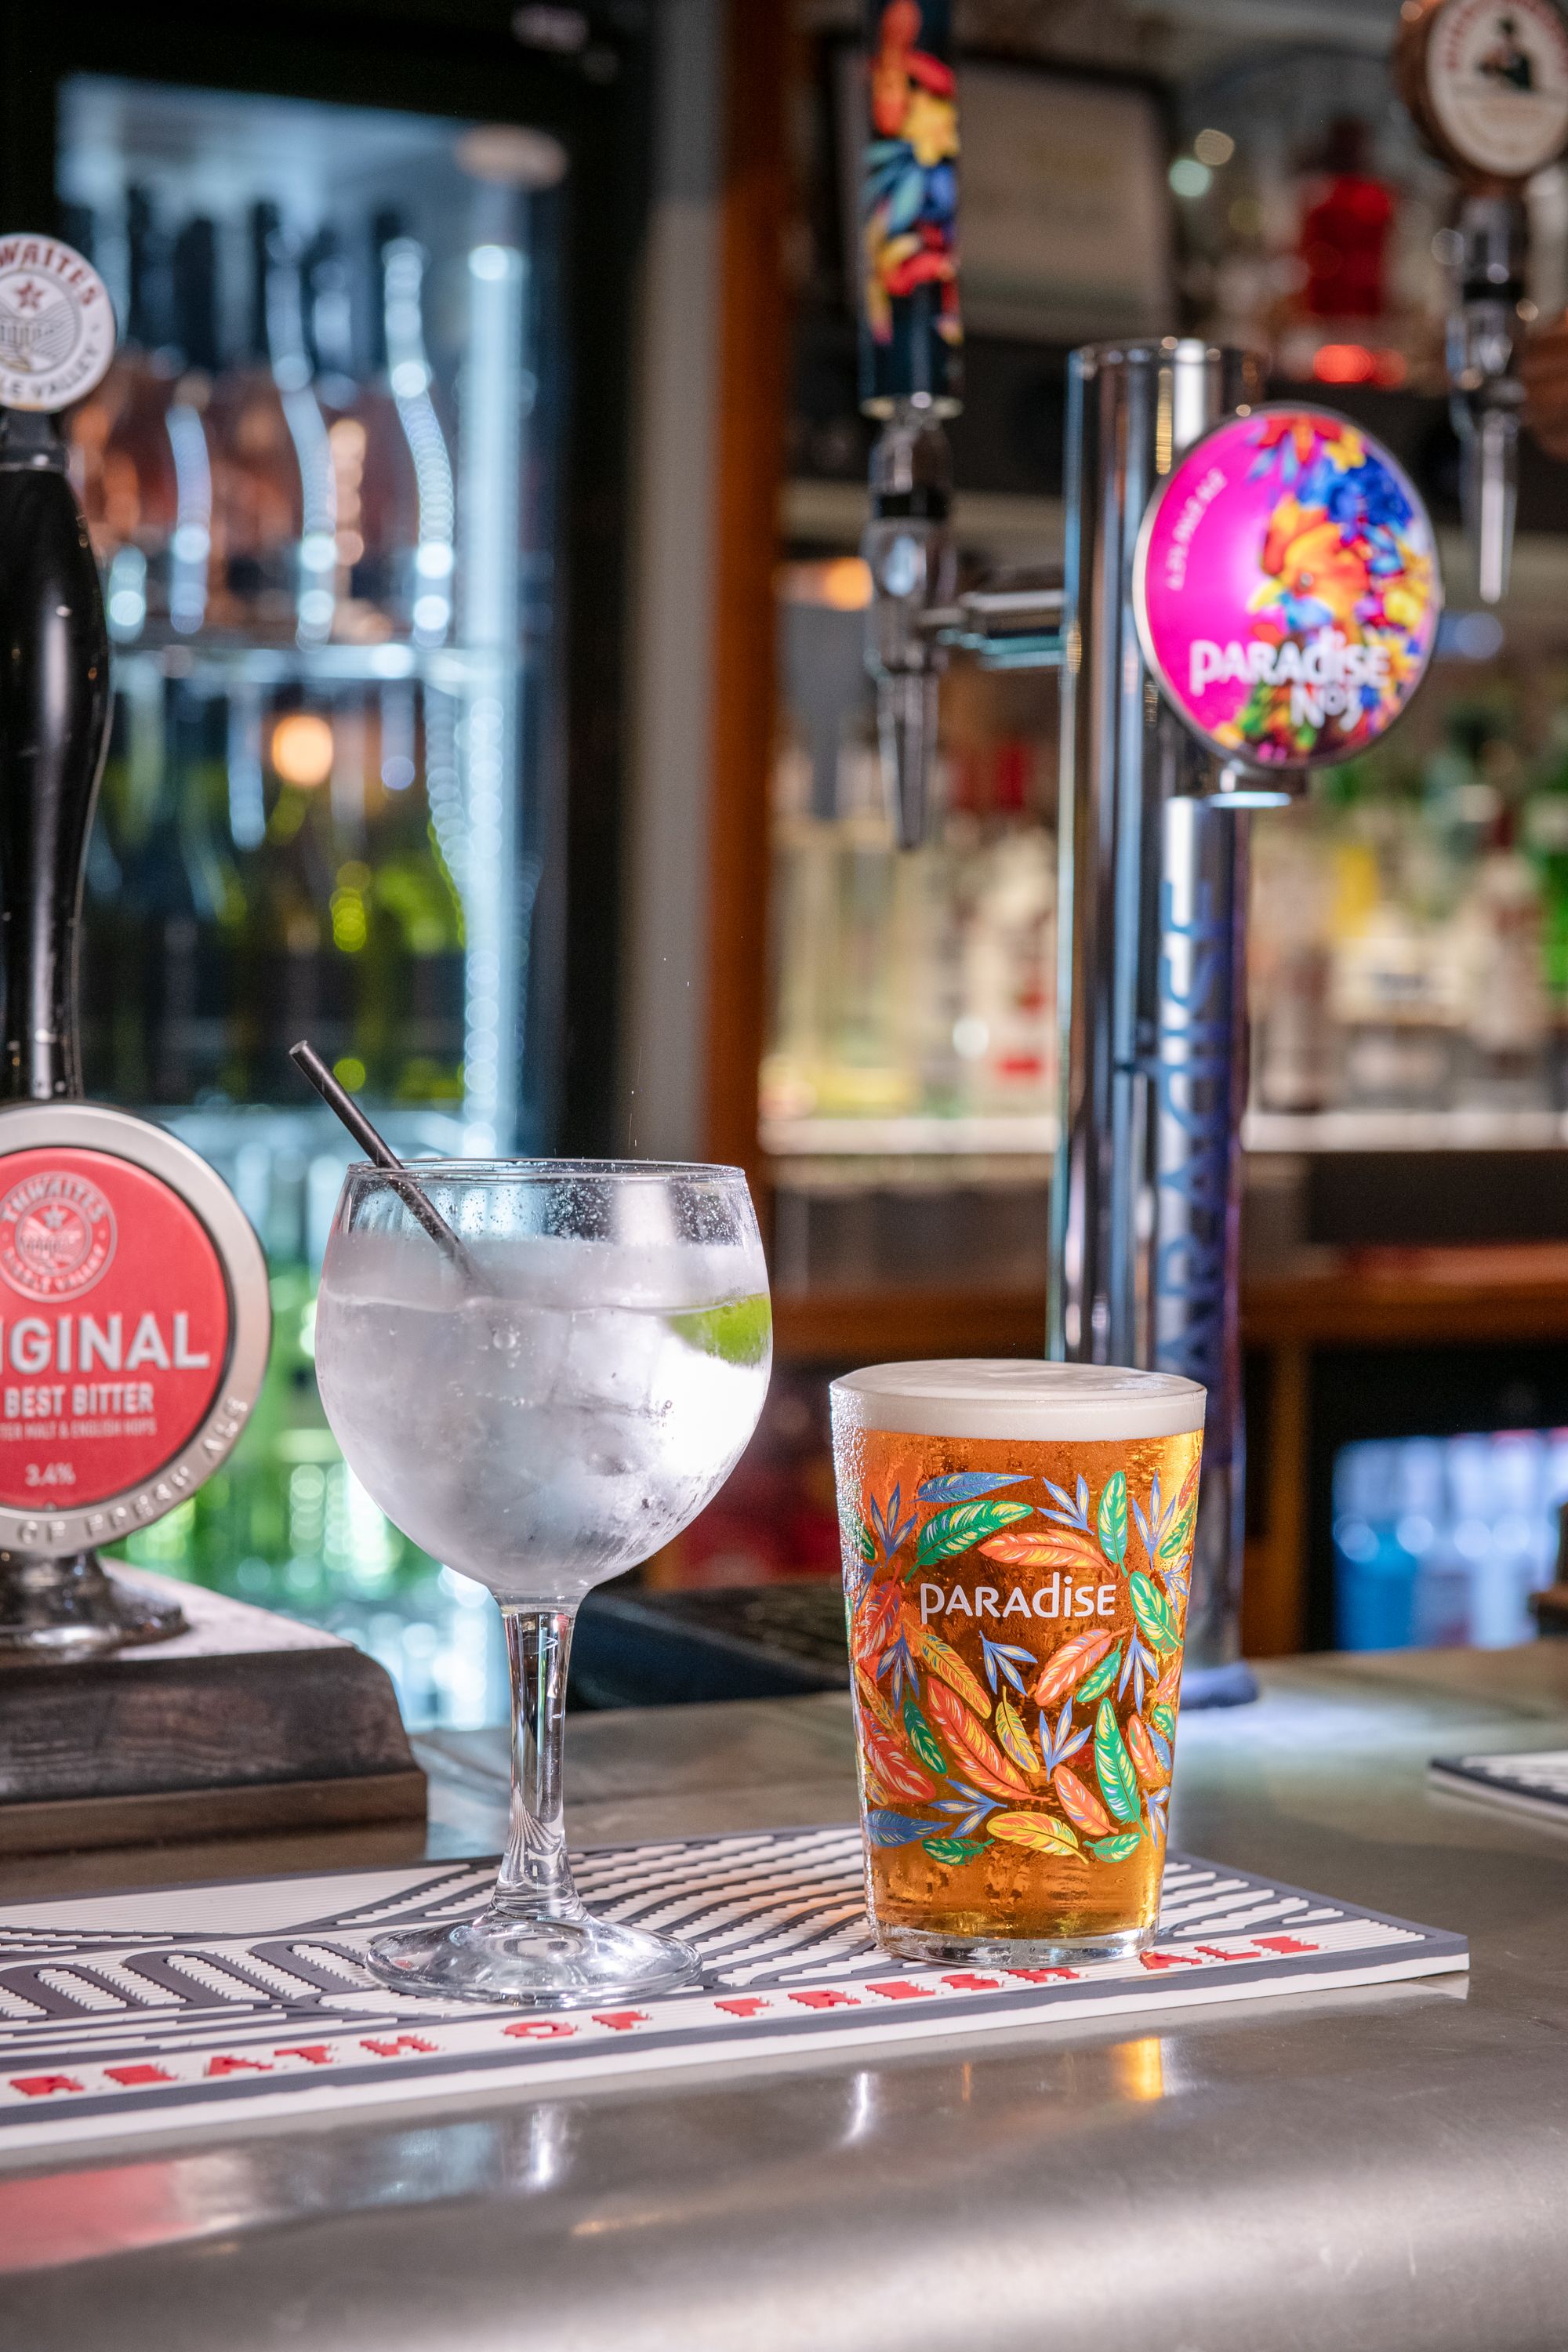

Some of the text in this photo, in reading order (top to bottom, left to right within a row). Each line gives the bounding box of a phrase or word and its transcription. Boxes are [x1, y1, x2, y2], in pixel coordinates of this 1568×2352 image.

[0, 1312, 210, 1374] GINAL
[5, 1381, 154, 1418] BEST BITTER
[24, 1462, 76, 1486] 3.4%
[1138, 1935, 1320, 1971] ALE
